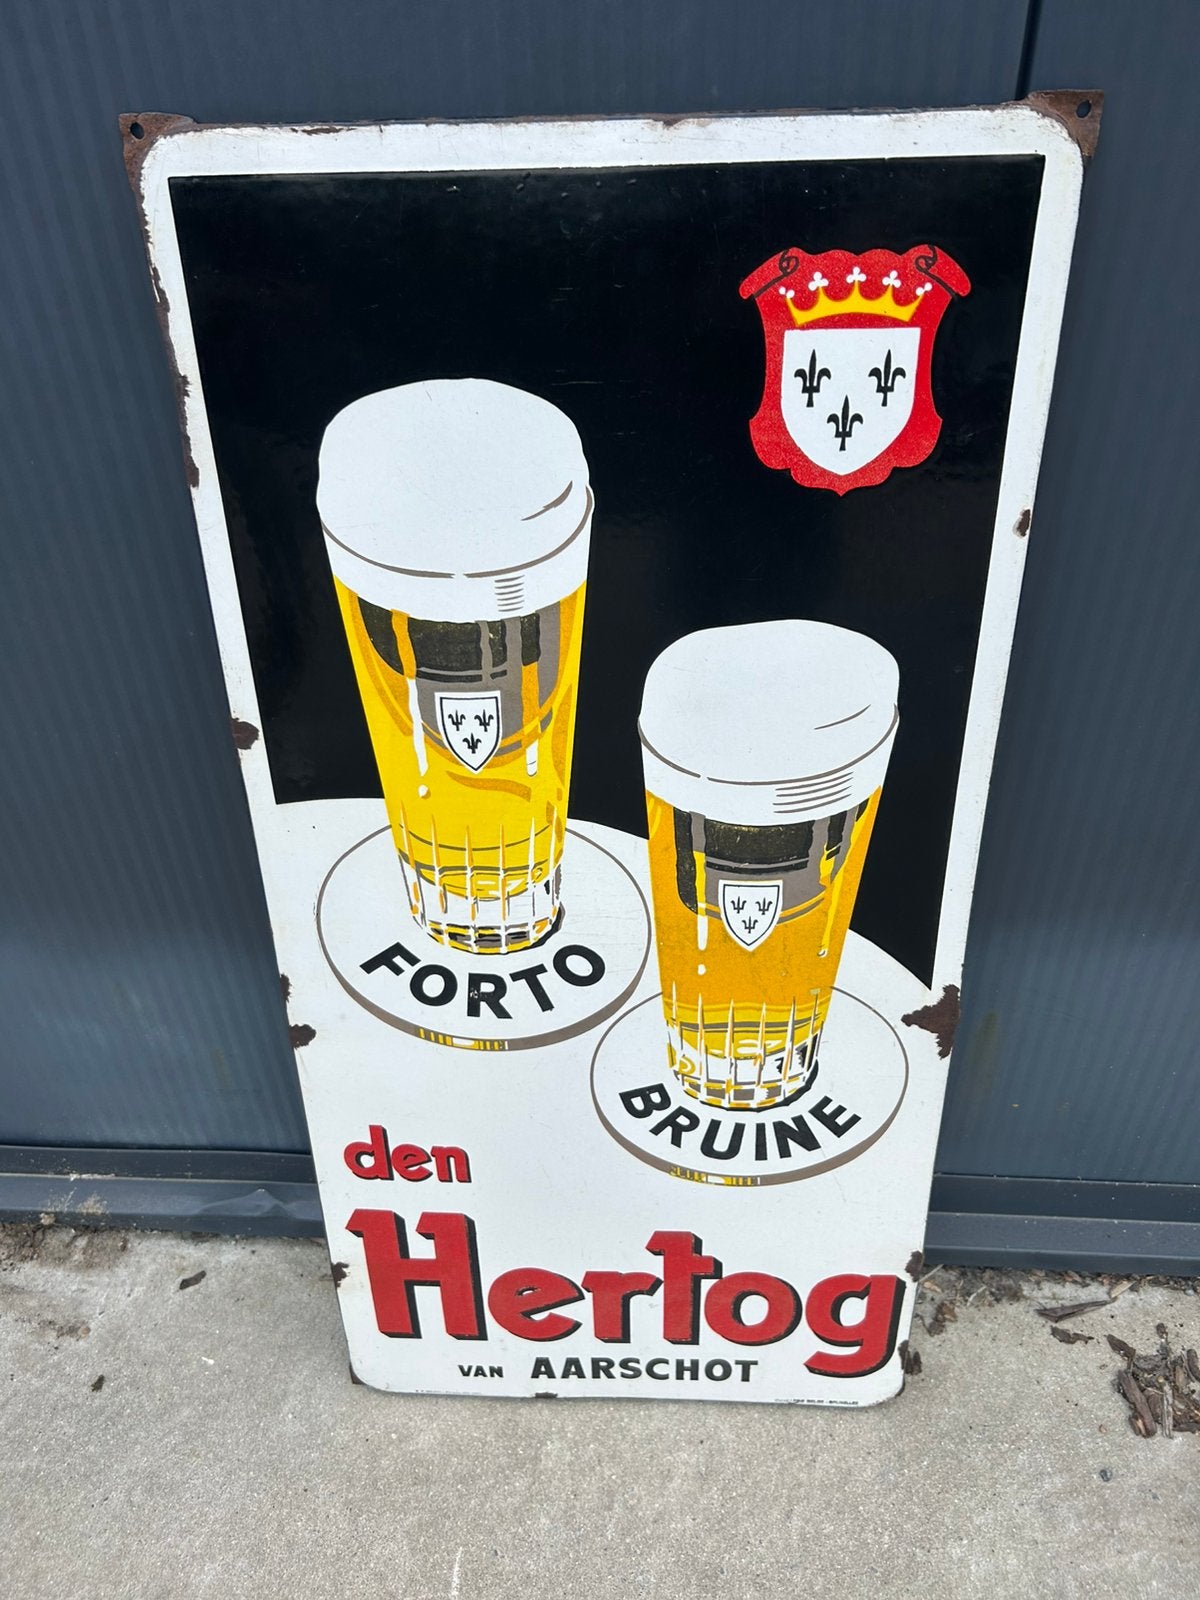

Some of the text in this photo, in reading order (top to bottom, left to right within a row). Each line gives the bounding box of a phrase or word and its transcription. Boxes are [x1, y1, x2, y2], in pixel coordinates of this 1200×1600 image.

[359, 942, 606, 1019] FORTO
[343, 1125, 472, 1183] den
[619, 1082, 862, 1161] BRUINE
[345, 1208, 906, 1378] Hertog
[458, 1356, 759, 1382] VAN AARSCHOT
